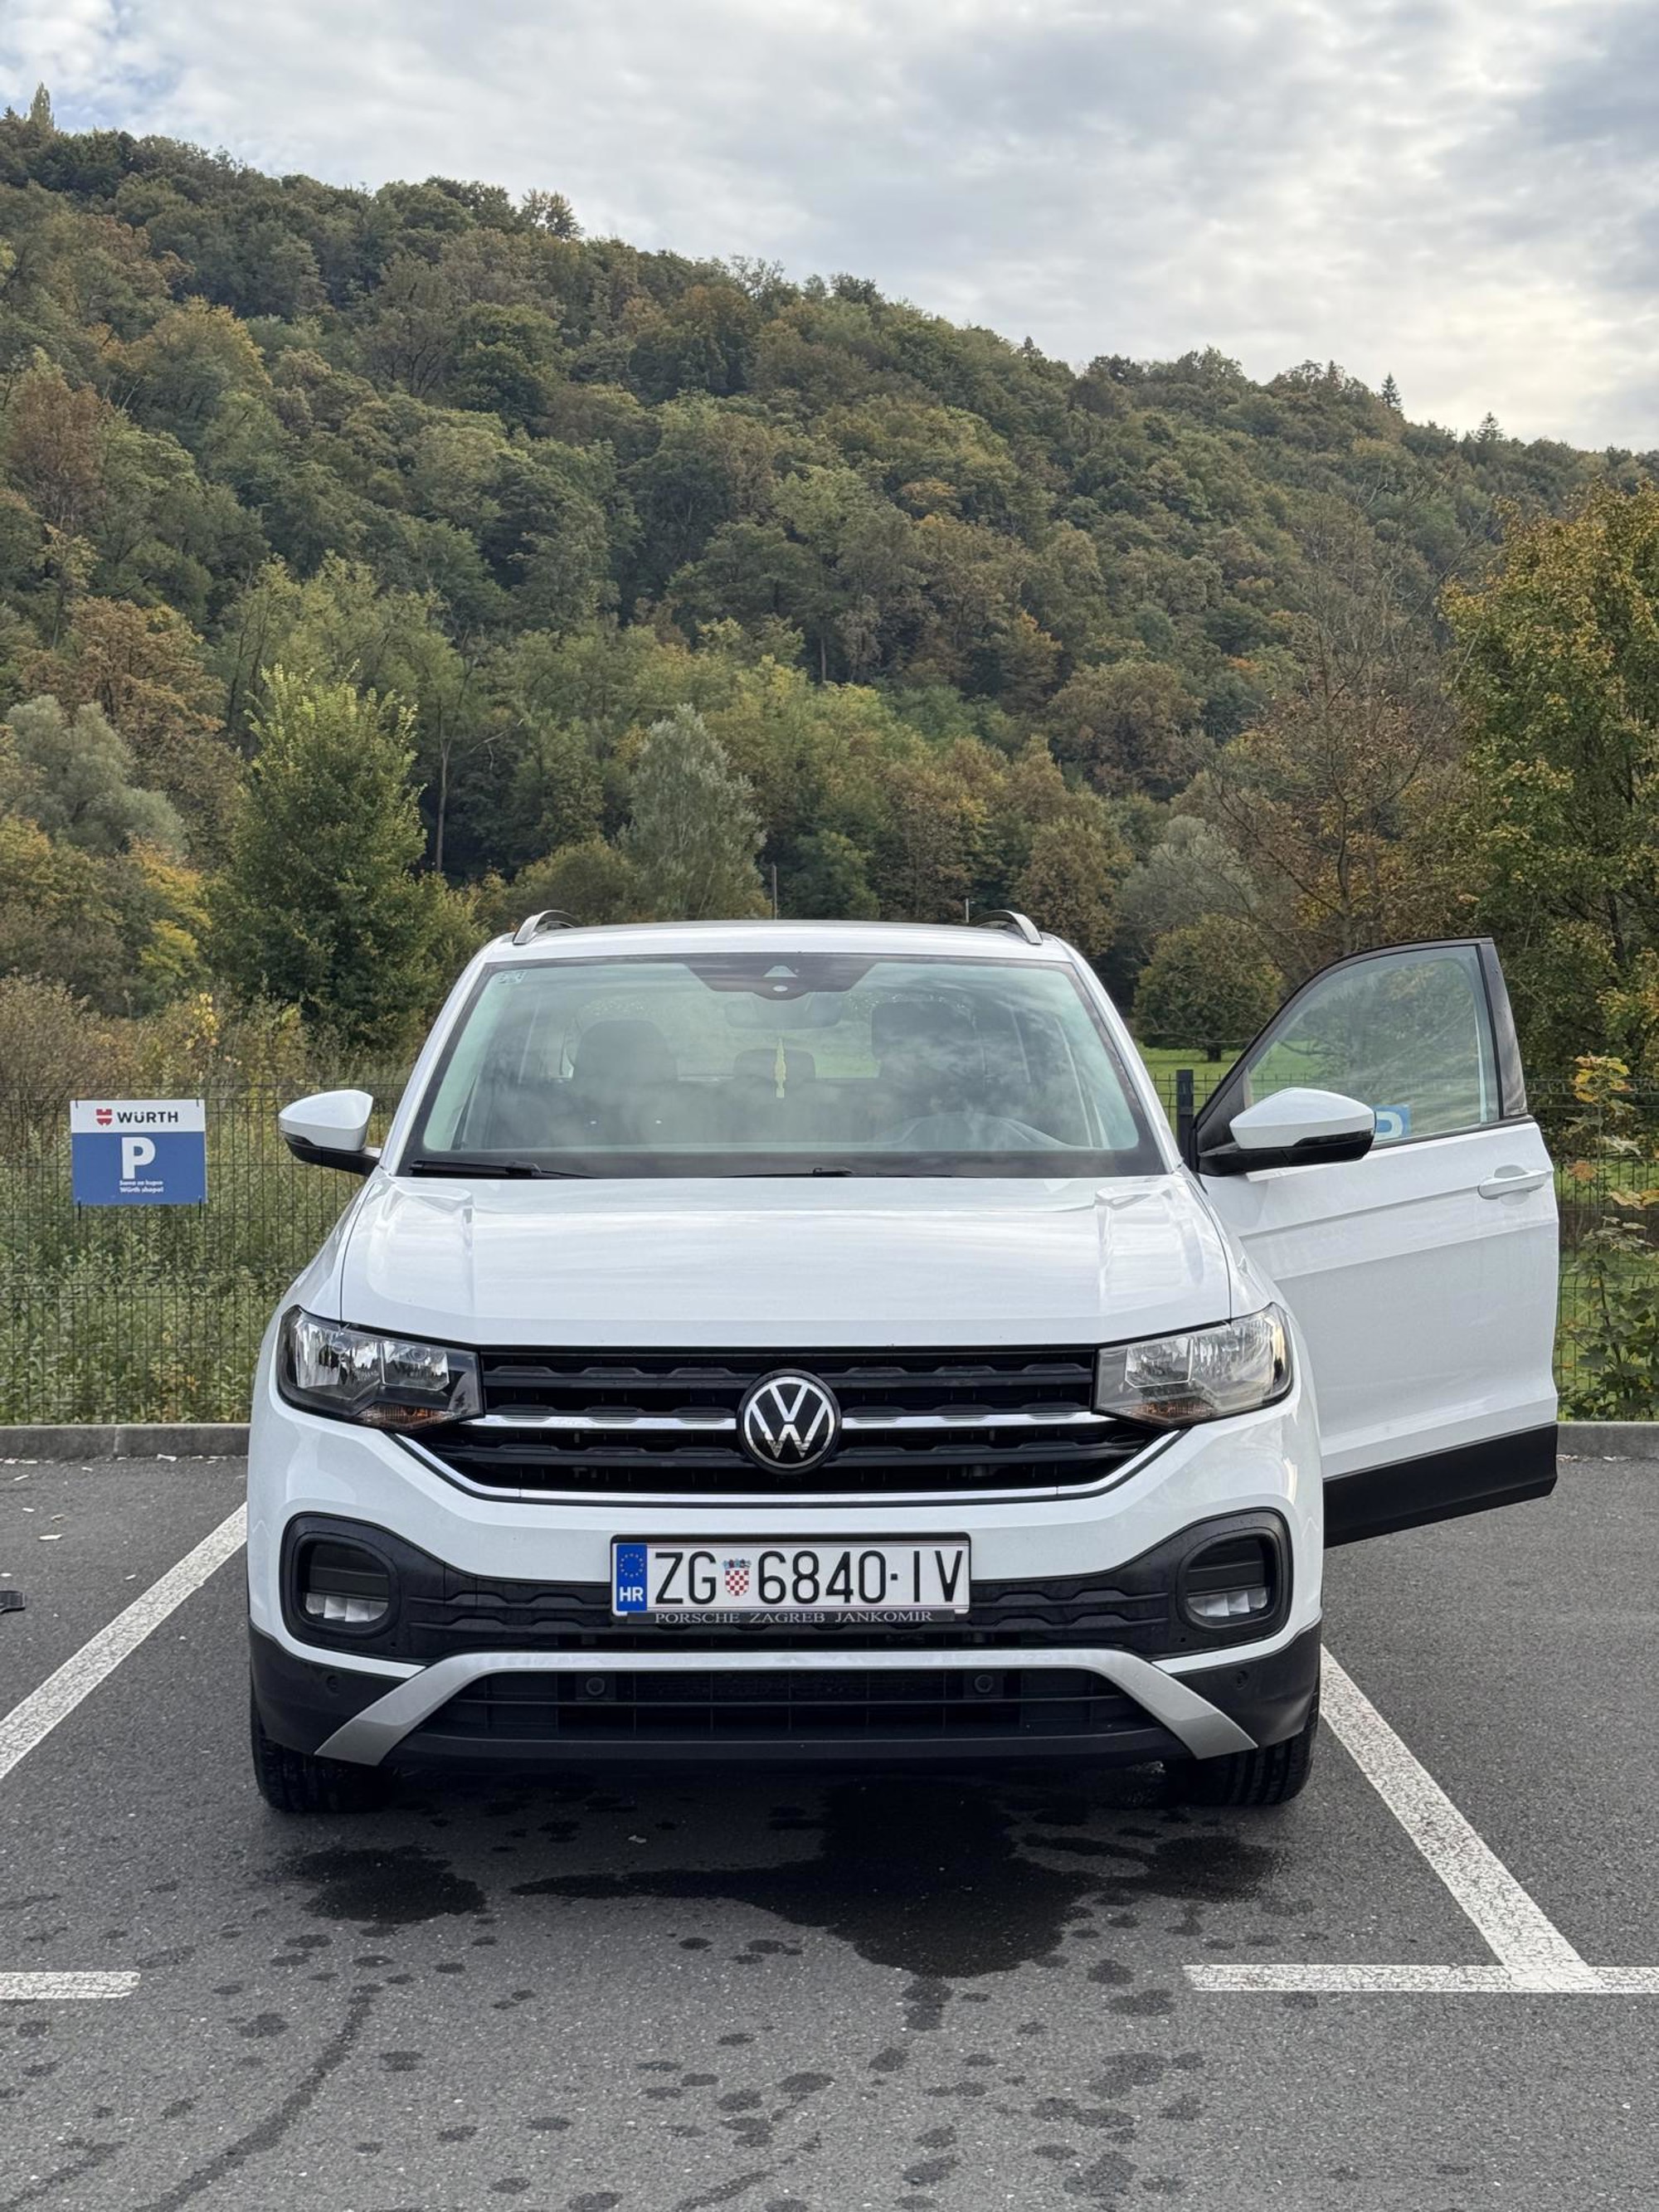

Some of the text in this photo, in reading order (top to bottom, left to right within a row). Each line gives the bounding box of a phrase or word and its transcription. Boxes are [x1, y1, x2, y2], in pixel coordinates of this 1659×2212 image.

[117, 1111, 178, 1123] WÜRTH
[122, 1137, 156, 1179] P
[654, 1551, 717, 1604] ZG
[620, 1587, 644, 1602] HR
[654, 1612, 934, 1624] PORSCHE ZAGREB JANKOMIR
